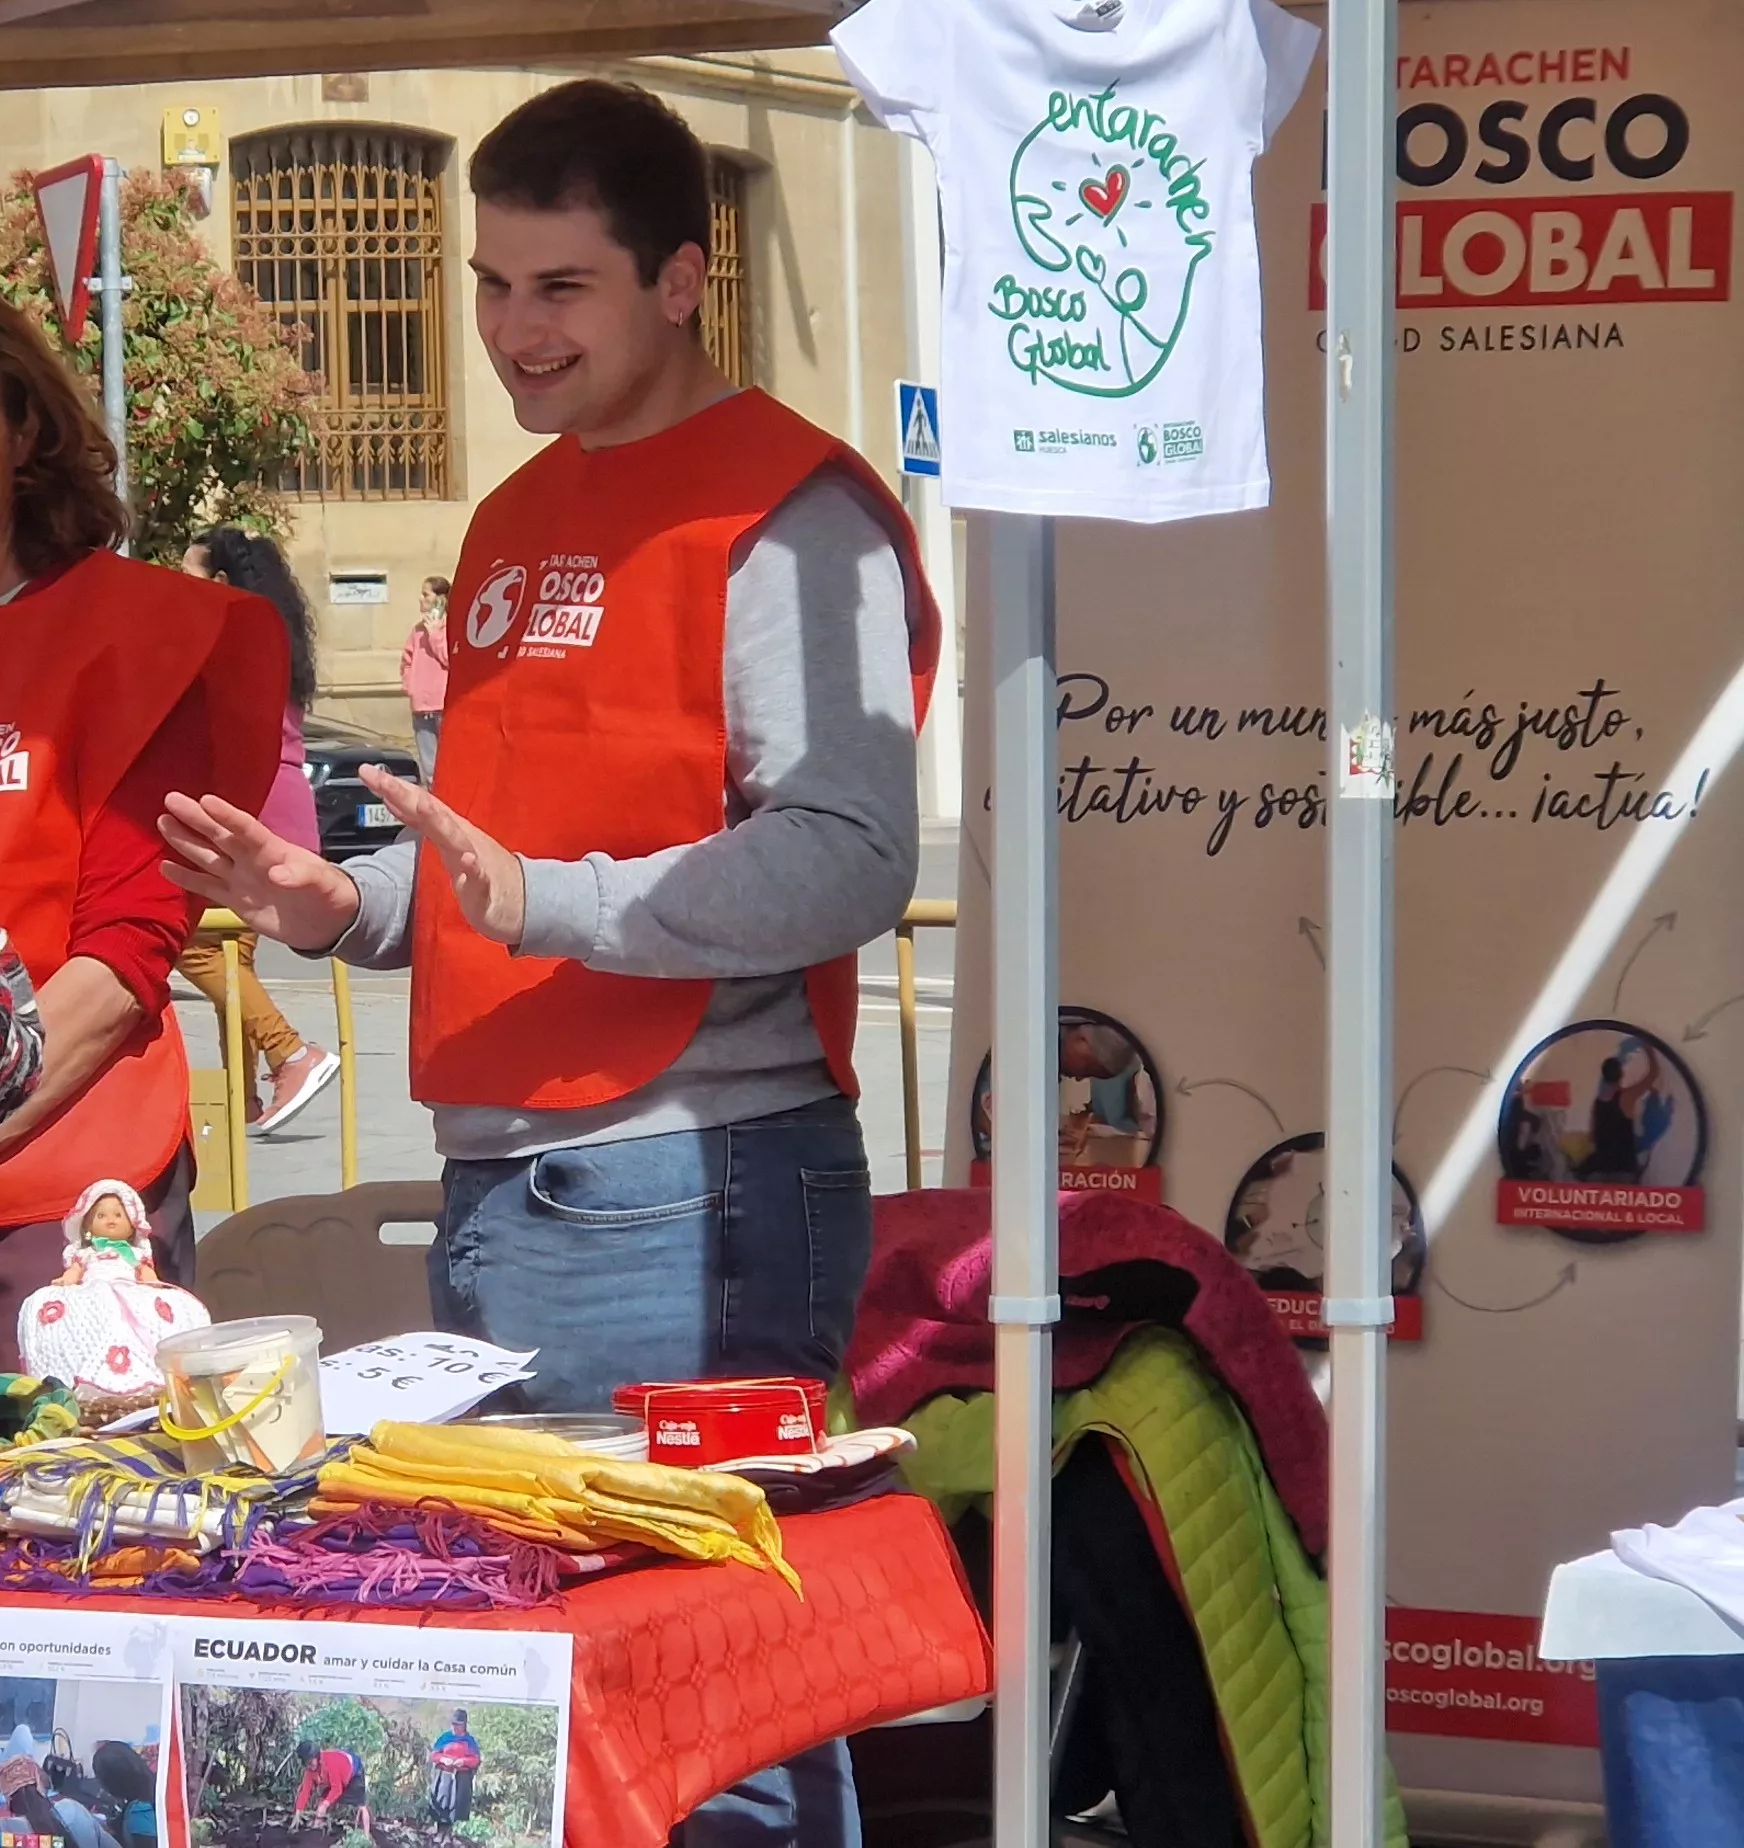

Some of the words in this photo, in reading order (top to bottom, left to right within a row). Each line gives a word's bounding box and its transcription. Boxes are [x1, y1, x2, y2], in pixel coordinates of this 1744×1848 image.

[1325, 46, 1632, 93] TARACHEN
[1321, 92, 1690, 190] OSCO
[1318, 206, 1716, 298] LOBAL
[987, 274, 1088, 321] Bosco
[1439, 322, 1626, 351] SALESIANA
[1007, 322, 1112, 386] Global
[1038, 427, 1118, 448] salesianos
[1162, 426, 1202, 442] BOSCO
[539, 571, 605, 603] OSCO
[525, 608, 594, 641] LOBAL
[1056, 673, 1155, 734] Por
[1170, 705, 1228, 741] un
[1409, 688, 1505, 750] más
[1489, 678, 1643, 781] justo,
[1206, 788, 1251, 858] y
[1518, 1187, 1683, 1209] VOLUNTARIADO
[1638, 1213, 1685, 1226] LOCAL
[427, 1356, 475, 1374] 10
[19, 1641, 112, 1657] oportunidades
[194, 1638, 317, 1665] ECUADOR
[323, 1655, 357, 1668] amar
[360, 1657, 369, 1670] y
[372, 1655, 414, 1671] cuidar
[418, 1659, 430, 1672] la
[434, 1660, 466, 1674] Casa
[469, 1661, 518, 1677] común
